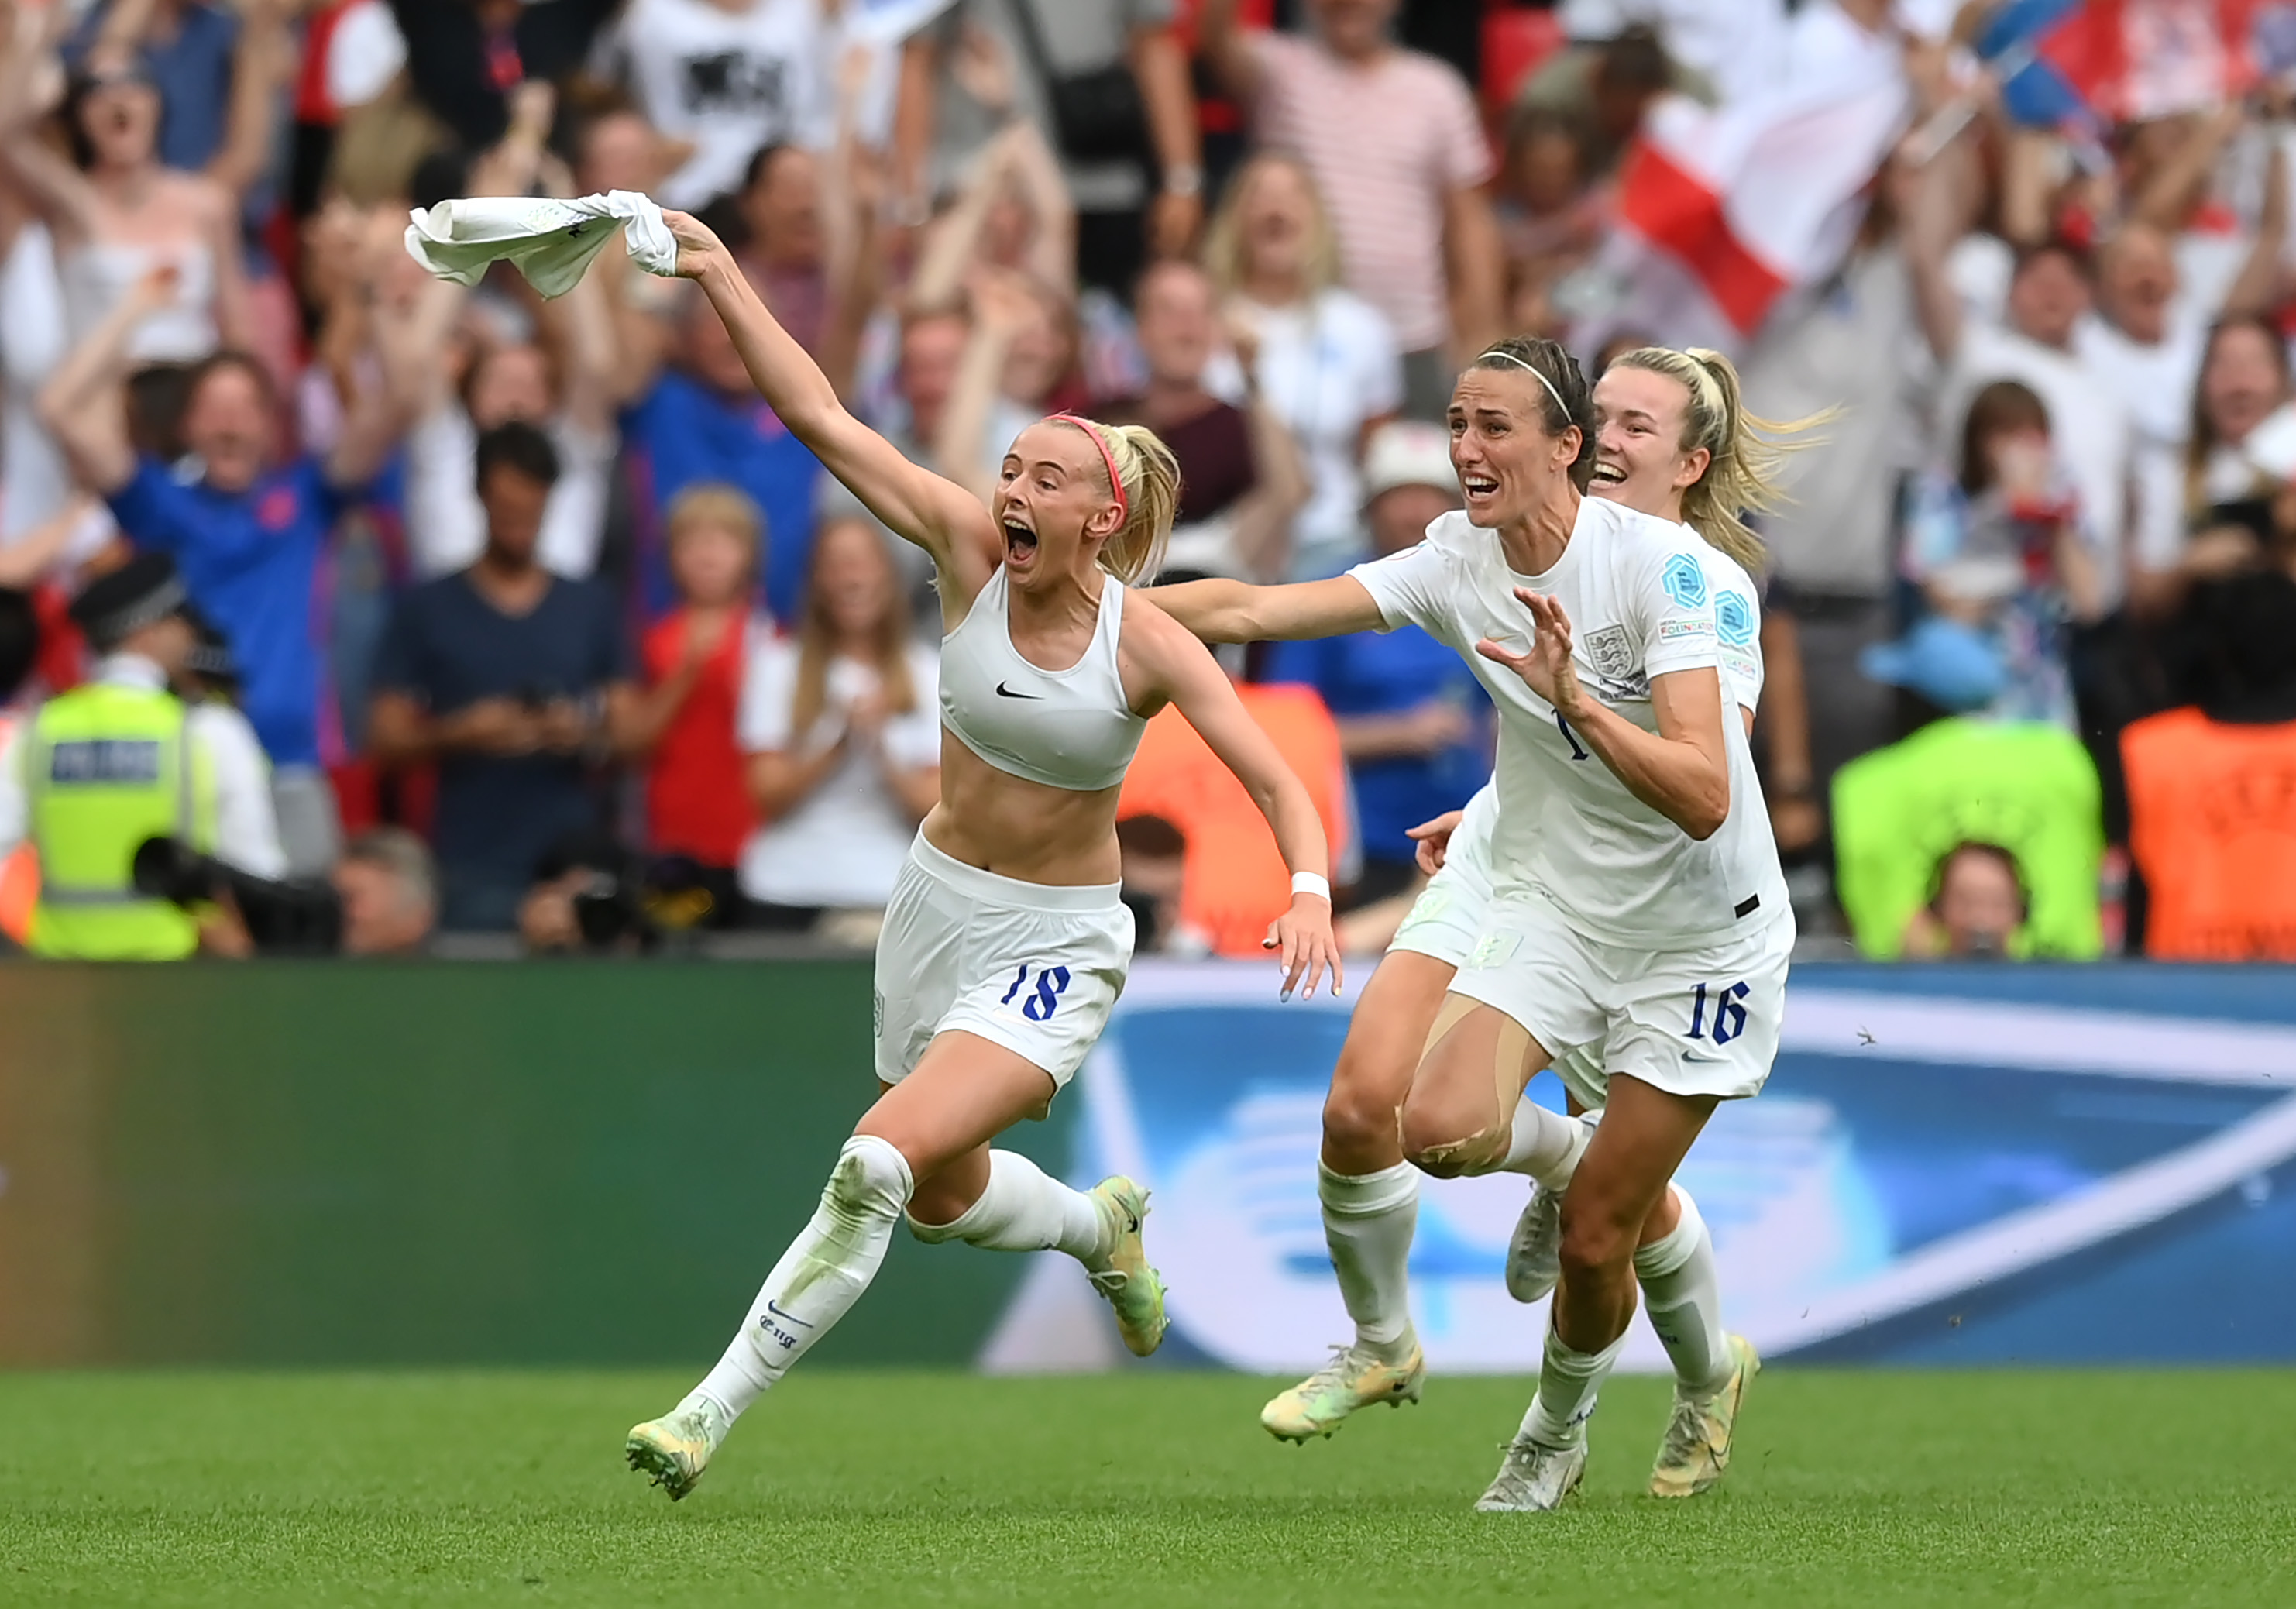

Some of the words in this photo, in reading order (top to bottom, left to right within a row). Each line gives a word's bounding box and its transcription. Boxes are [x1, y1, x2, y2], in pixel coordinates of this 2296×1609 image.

[1000, 964, 1071, 1021] 18
[1682, 980, 1751, 1046] 16
[760, 1315, 797, 1349] Eng
